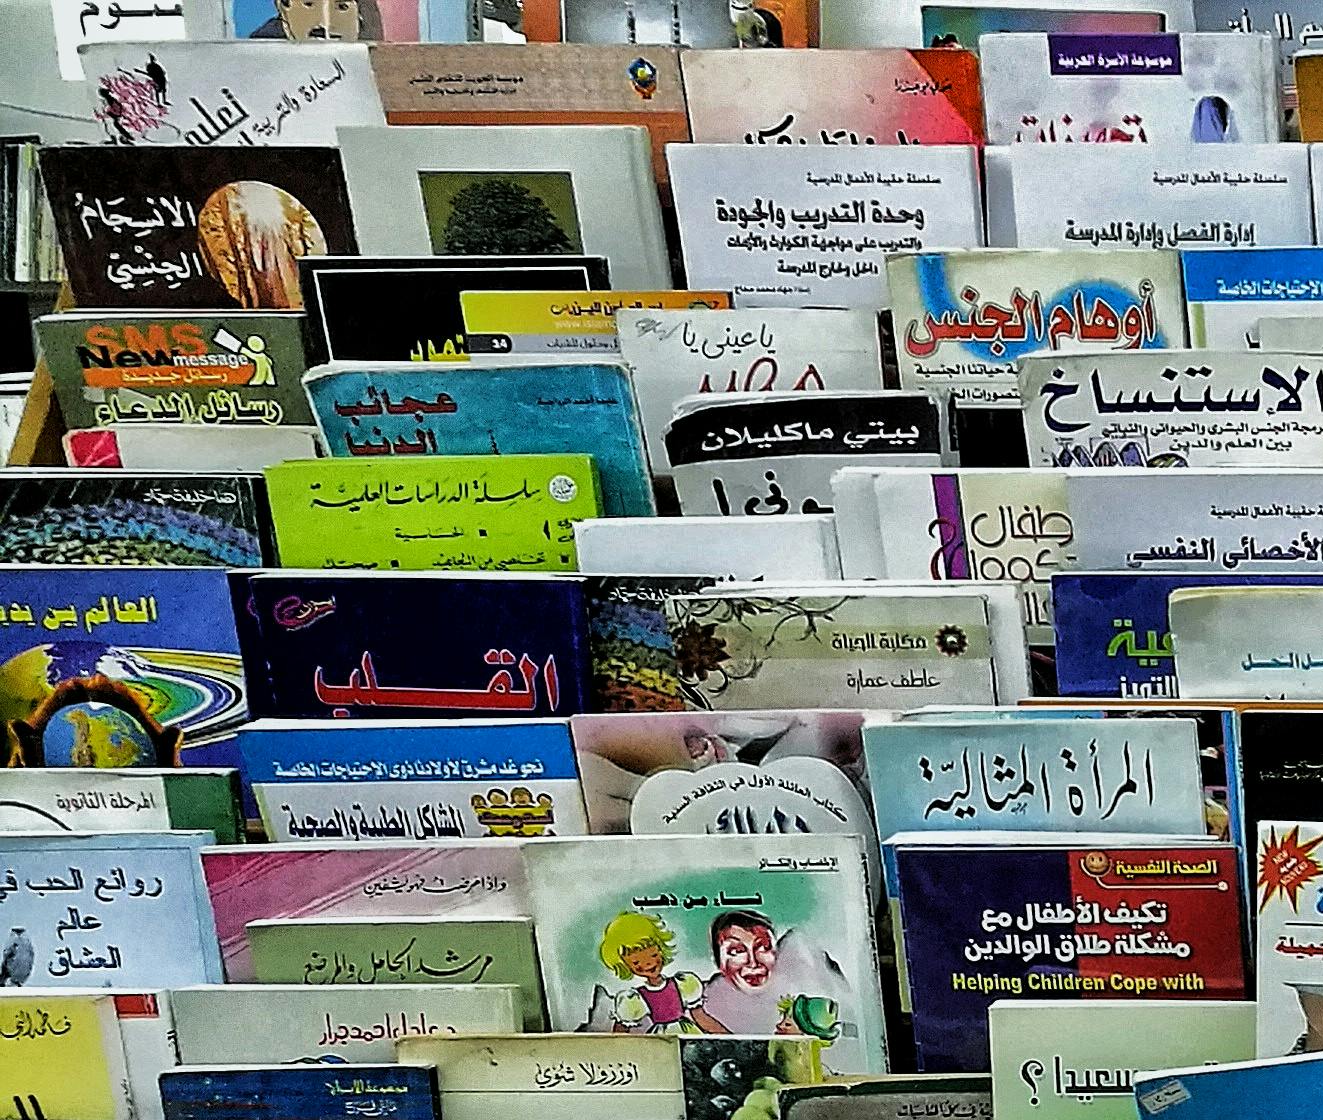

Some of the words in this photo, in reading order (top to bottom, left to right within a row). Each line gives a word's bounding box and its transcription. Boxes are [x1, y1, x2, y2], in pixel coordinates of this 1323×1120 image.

[85, 324, 208, 355] SMS
[172, 353, 249, 373] message
[314, 650, 558, 718] القلب
[56, 911, 103, 940] عالم
[981, 903, 1013, 929] مع
[1104, 900, 1169, 924] تكيف
[964, 934, 1050, 962] الوالدين
[1054, 932, 1110, 962] طلاق
[1114, 930, 1192, 961] مشكلة
[952, 972, 1022, 995] Helping
[1027, 972, 1104, 993] Children
[1109, 973, 1159, 995] Cope
[1161, 973, 1204, 991] with
